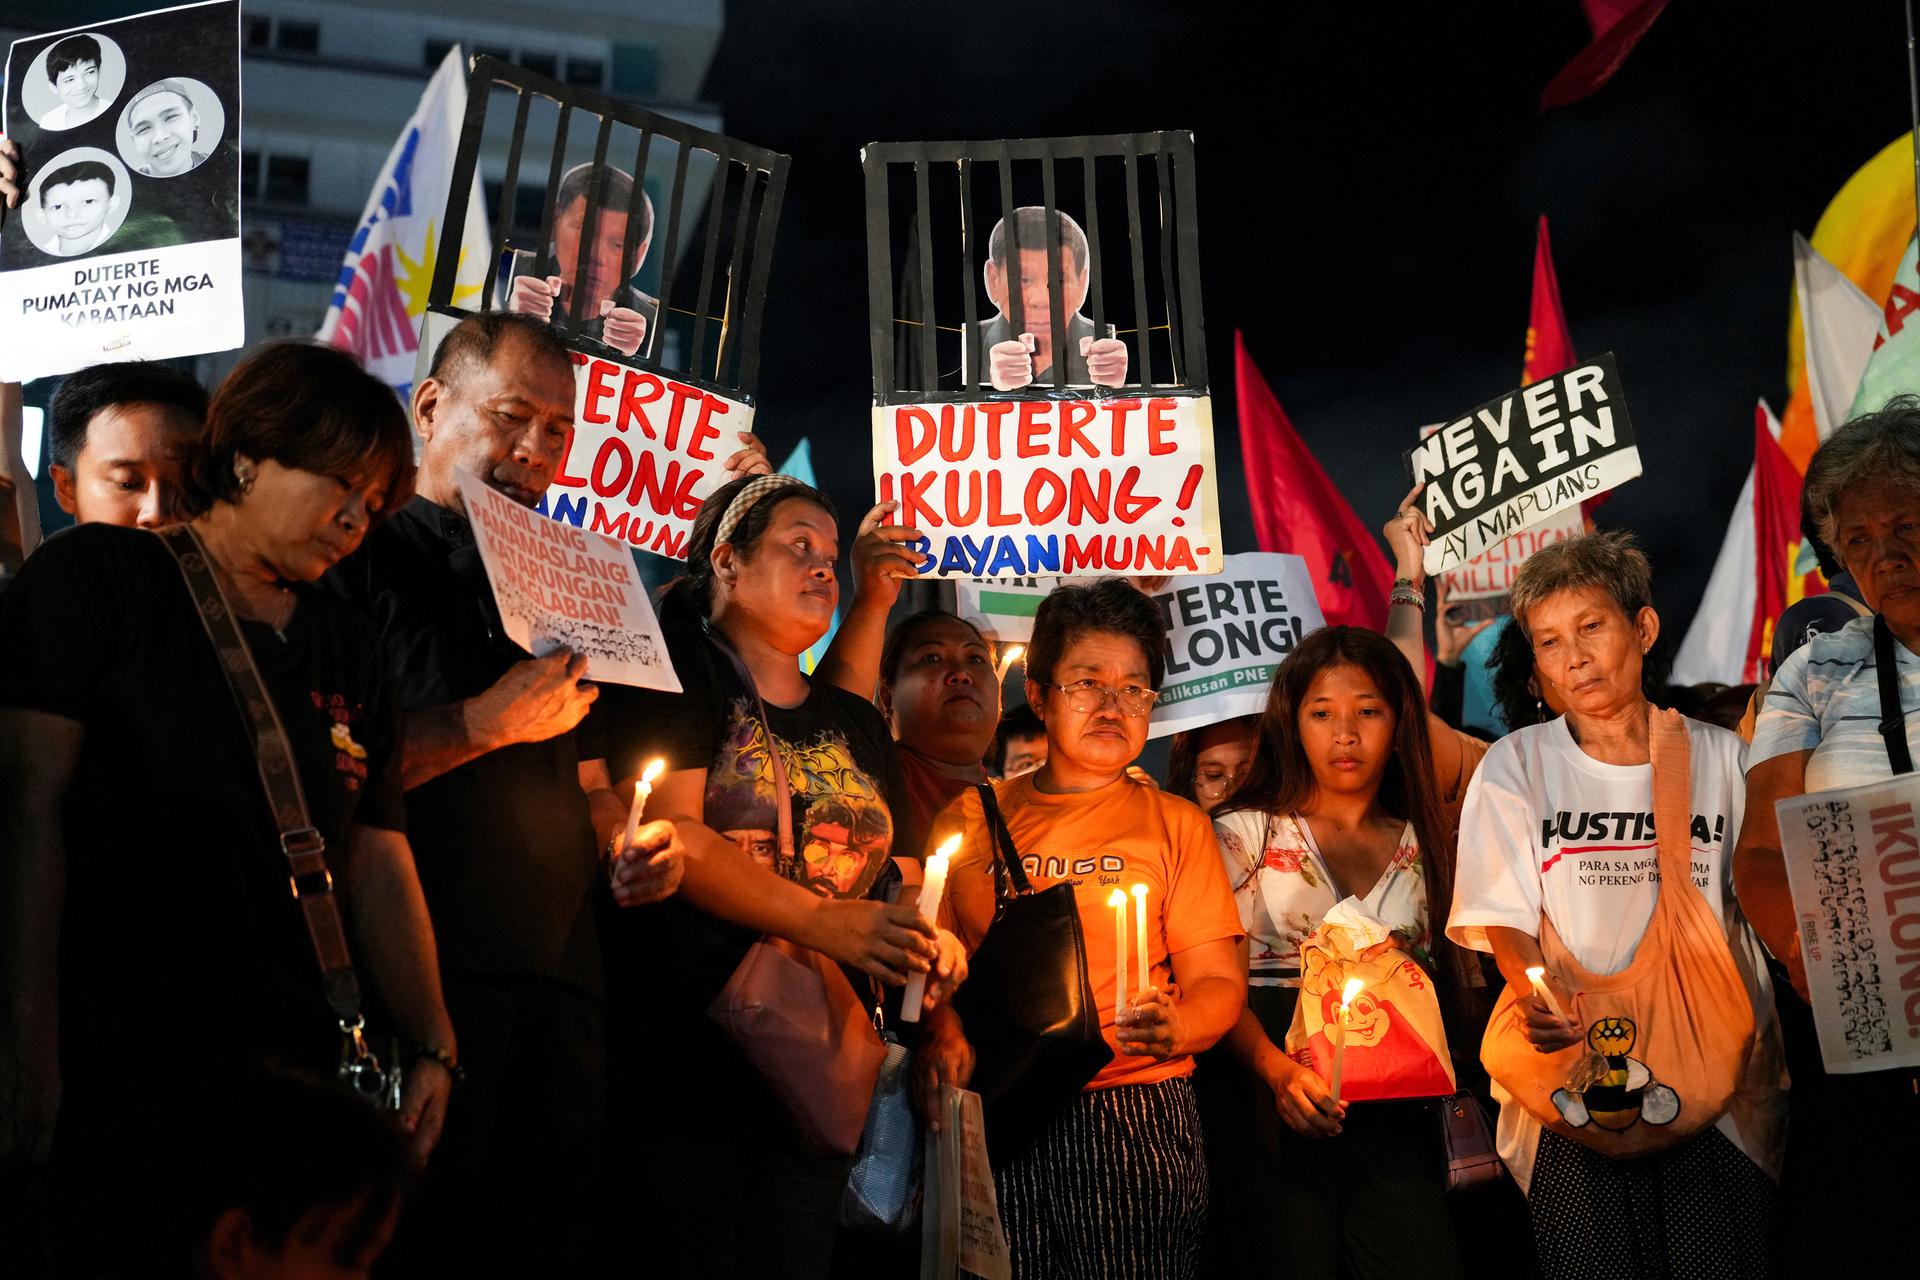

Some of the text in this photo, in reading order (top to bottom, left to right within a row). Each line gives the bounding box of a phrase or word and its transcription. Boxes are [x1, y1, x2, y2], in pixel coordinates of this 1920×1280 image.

[74, 258, 160, 286] DUTERTE
[22, 273, 214, 314] PUMATAY NG MGA
[60, 299, 174, 328] KABATAAN
[571, 352, 729, 461] ERTE
[1411, 365, 1608, 484] NEVER
[896, 398, 1178, 466] DUTERTE
[1426, 406, 1616, 528] AGAIN
[487, 489, 587, 552] ITIGIL ANG
[1440, 464, 1600, 569] AY MAPUANS
[470, 500, 632, 585] PAMAMASLANG!
[486, 531, 627, 607] KATARUNGAN
[1233, 667, 1268, 684] PNE
[1542, 811, 1725, 848] HUSTISA!
[1098, 874, 1121, 887] York
[1578, 875, 1596, 886] NG
[1599, 872, 1644, 886] PEKENG
[1691, 876, 1709, 888] AR
[1579, 860, 1610, 872] PARA
[1614, 861, 1630, 872] SA
[1633, 857, 1658, 872] MGA
[1806, 921, 1819, 945] RISE
[1870, 801, 1920, 1039] IKULON
[1810, 946, 1822, 962] UP
